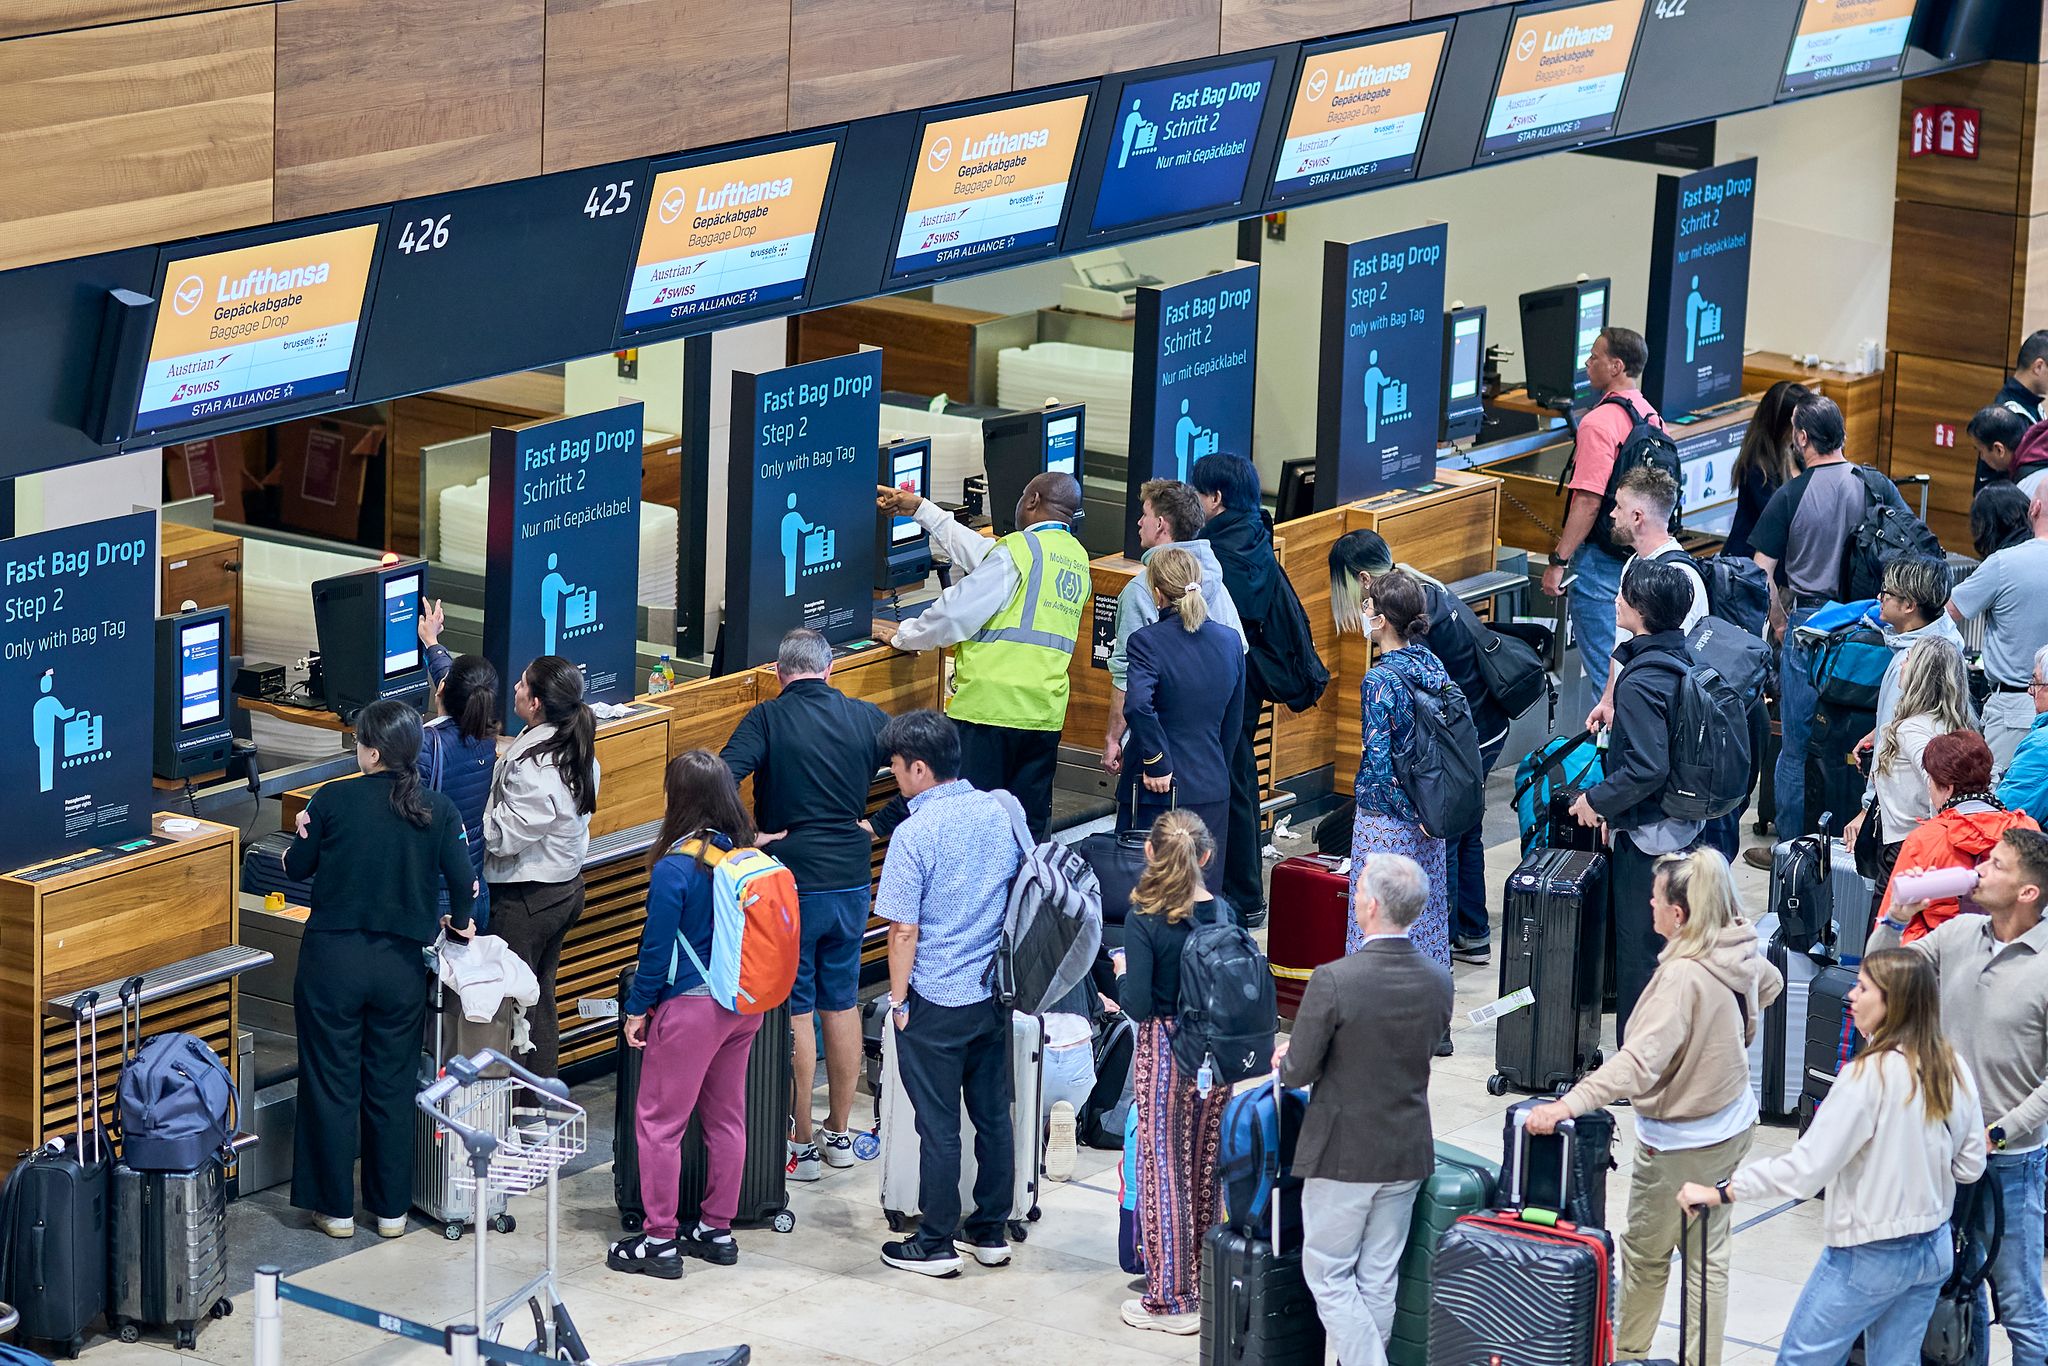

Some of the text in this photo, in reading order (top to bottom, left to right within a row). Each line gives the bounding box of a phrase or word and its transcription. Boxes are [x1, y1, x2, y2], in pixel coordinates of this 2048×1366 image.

[1543, 24, 1614, 53] Lufthansa
[1335, 62, 1411, 93] Lufthansa
[1815, 62, 1863, 80] STAR ALLIANCE
[1170, 81, 1261, 111] Fast Bag Drop
[1332, 88, 1391, 107] Gepäckabgabe
[1163, 112, 1220, 140] Schritt 2
[1328, 104, 1380, 123] Baggage Drop
[1516, 114, 1537, 126] SWISS
[961, 128, 1049, 162] Lufthansa
[1517, 121, 1573, 142] STAR ALLIANCE
[1156, 139, 1246, 169] Nur mit Gepäcklabel
[1296, 138, 1328, 153] Austrian
[958, 155, 1027, 178] Gepäckabgabe
[1308, 156, 1330, 169] SWISS
[1309, 164, 1369, 186] STAR ALLIANCE
[695, 177, 793, 213] Lufthansa
[954, 174, 1015, 195] Baggage Drop
[1683, 178, 1751, 209] Fast Bag Drop
[584, 180, 633, 218] 425
[1009, 193, 1034, 206] brussels
[692, 206, 768, 230] Gepäckabgabe
[919, 210, 956, 228] Austrian
[1681, 209, 1719, 236] Schritt 2
[398, 215, 451, 255] 426
[688, 225, 756, 248] Baggage Drop
[934, 230, 959, 245] SWISS
[750, 245, 777, 258] brussels
[937, 238, 1005, 263] STAR ALLIANCE
[1353, 245, 1439, 278] Fast Bag Drop
[217, 262, 330, 303] Lufthansa
[650, 263, 691, 282] Austrian
[667, 285, 695, 300] SWISS
[670, 292, 746, 318] STAR ALLIANCE
[1352, 282, 1387, 308] Step 2
[214, 294, 302, 321] Gepäckabgabe
[1166, 288, 1250, 326] Fast Bag Drop
[210, 314, 289, 340] Baggage Drop
[1350, 308, 1424, 337] Only with Bag Tag
[283, 337, 314, 350] brussels
[1164, 324, 1212, 356] Schritt 2
[167, 358, 214, 378] Austrian
[1162, 349, 1246, 386] Nur mit Gepäcklabel
[187, 380, 219, 396] SWISS
[764, 375, 872, 413] Fast Bag Drop
[192, 388, 280, 416] STAR ALLIANCE
[762, 417, 807, 446] Step 2
[525, 429, 635, 471] Fast Bag Drop
[761, 446, 855, 479] Only with Bag Tag
[523, 469, 585, 505] Schritt 2
[522, 497, 630, 539] Nur mit Gepäcklabel
[6, 539, 145, 585] Fast Bag Drop
[1050, 552, 1072, 569] Mobility
[5, 588, 63, 622] Step 2
[5, 620, 126, 659] Only with Bag Tag
[378, 1313, 402, 1333] BER
